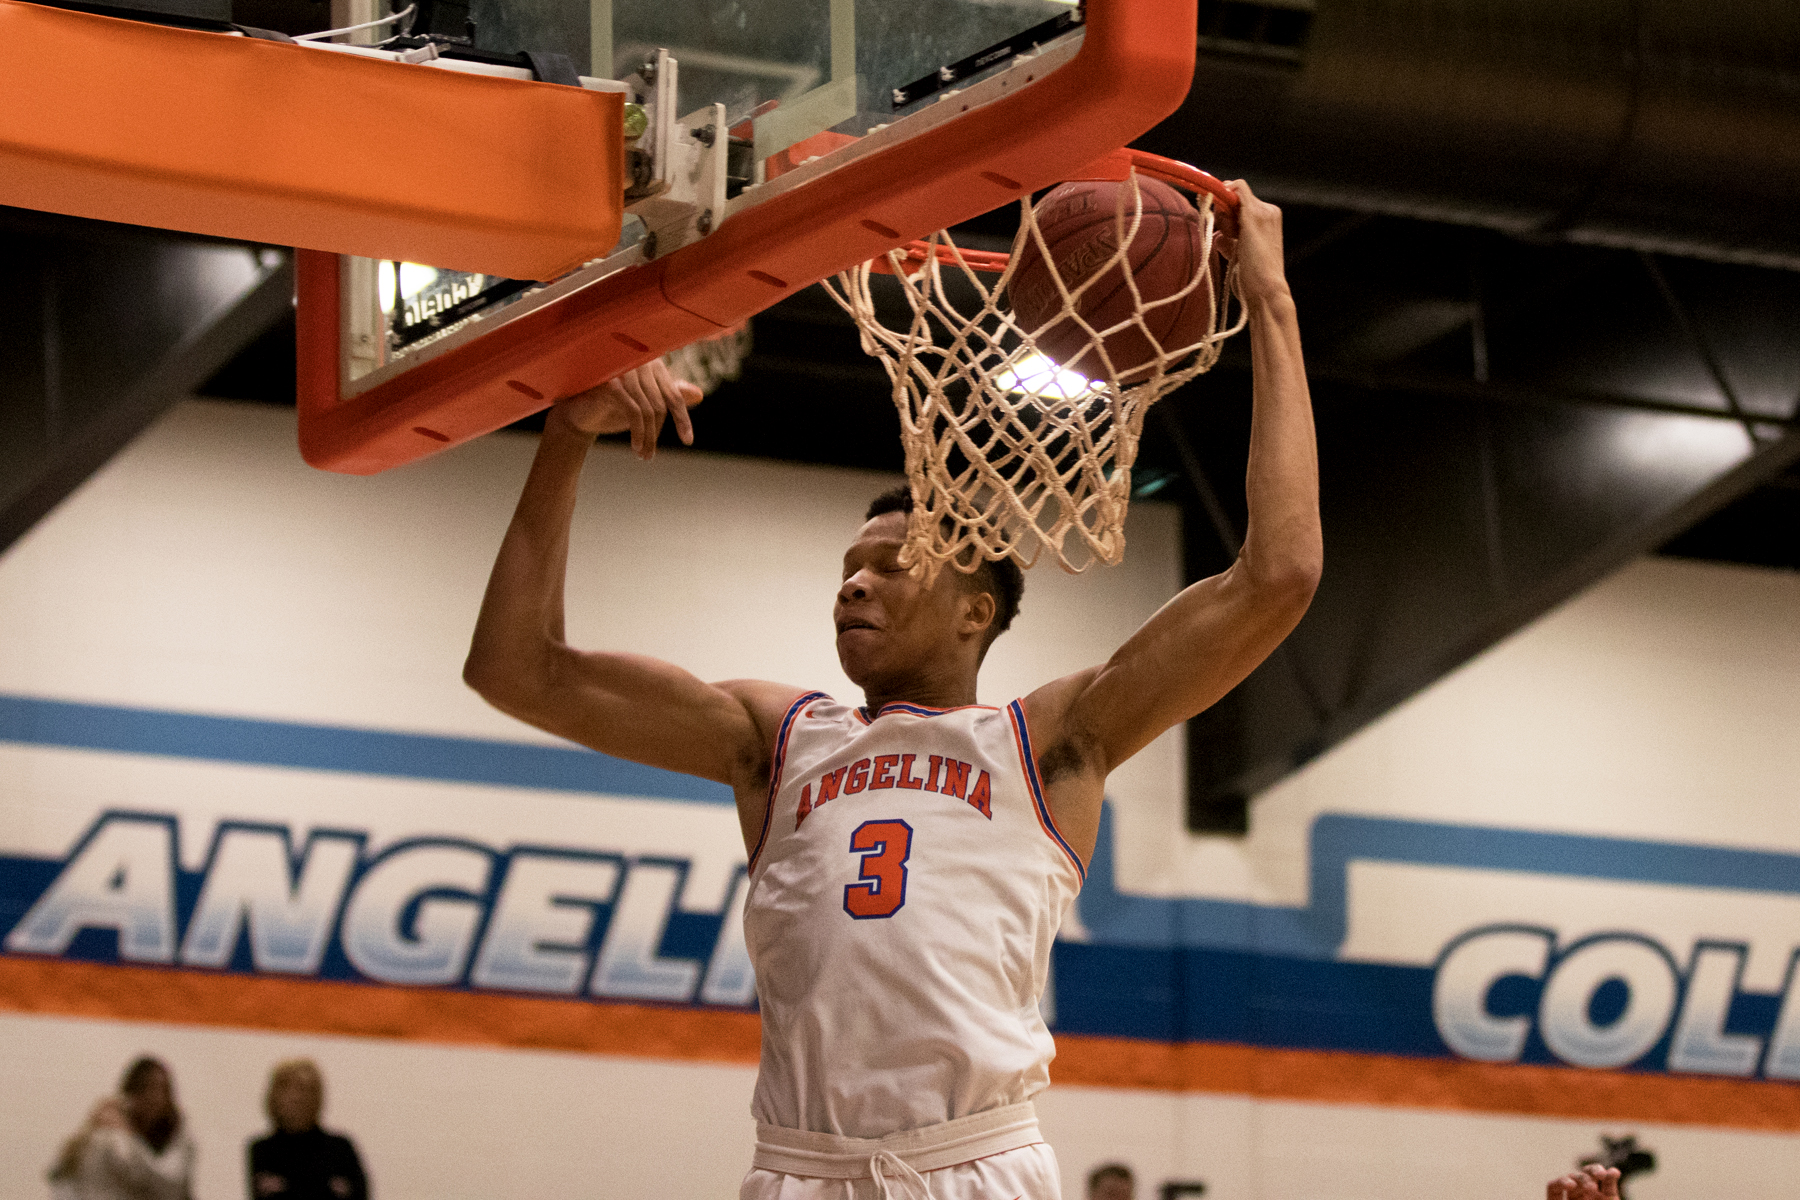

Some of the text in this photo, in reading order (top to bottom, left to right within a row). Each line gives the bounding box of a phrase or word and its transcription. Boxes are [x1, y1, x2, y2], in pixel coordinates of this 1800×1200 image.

[795, 753, 993, 832] ANGELINA
[2, 808, 759, 1010] ANGELI
[843, 818, 914, 920] 3
